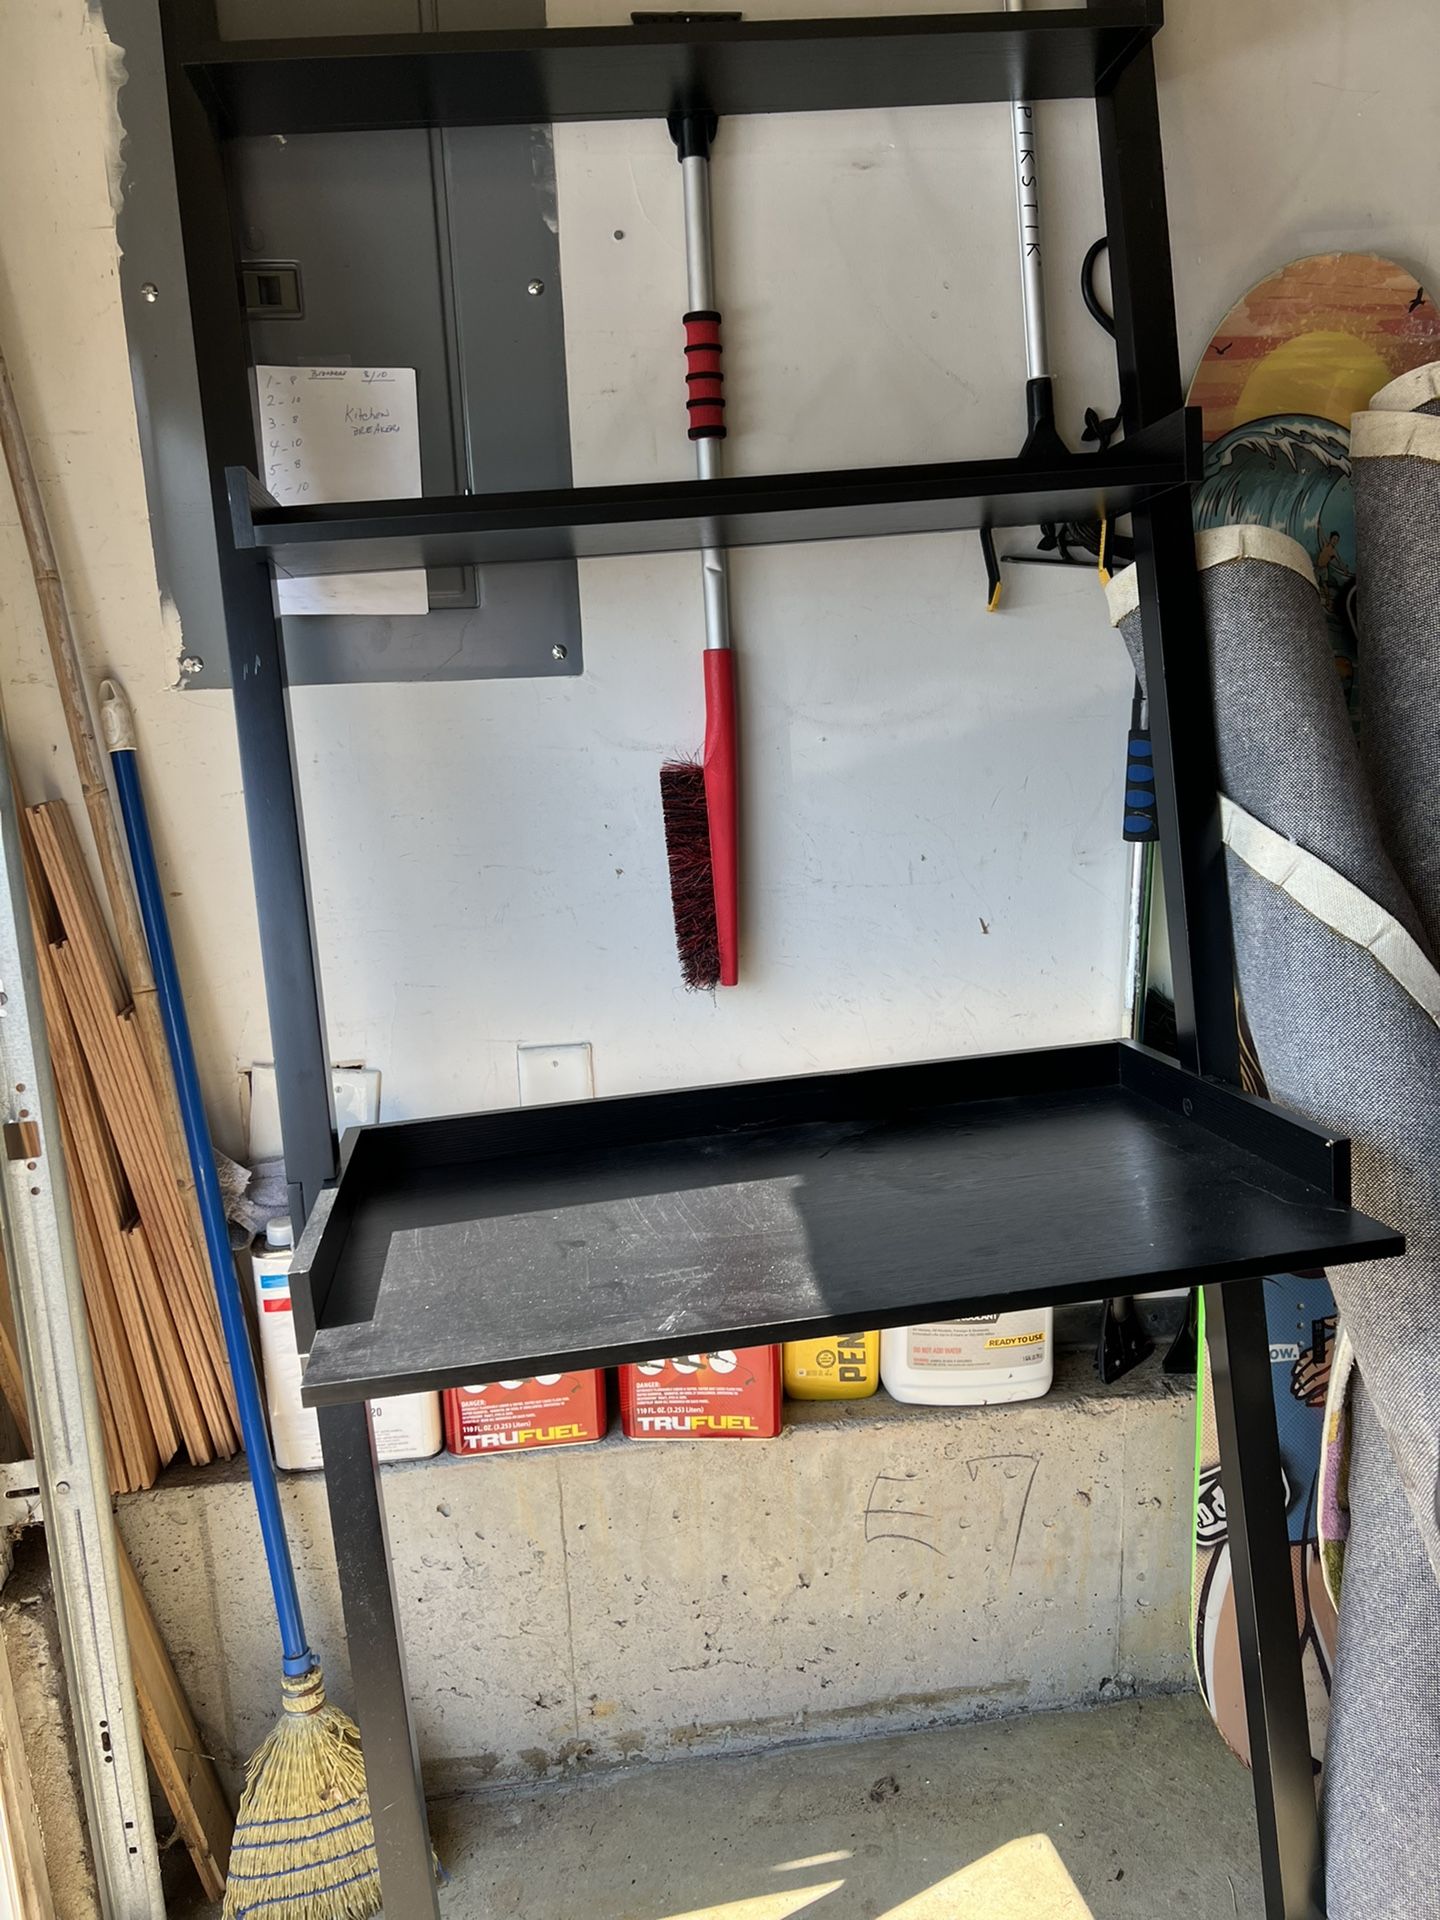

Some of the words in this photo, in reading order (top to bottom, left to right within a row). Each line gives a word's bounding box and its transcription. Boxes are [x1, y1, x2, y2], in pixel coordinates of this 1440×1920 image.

[1017, 105, 1041, 256] PIKSTIK
[988, 1337, 1017, 1347] READY
[1017, 1336, 1028, 1344] TO
[1028, 1332, 1044, 1342] USE
[647, 1406, 656, 1414] FL.
[657, 1406, 667, 1414] OZ.
[685, 1405, 705, 1414] Liters)
[463, 1425, 474, 1433] 110
[474, 1424, 483, 1432] FL.
[483, 1423, 494, 1431] OZ.
[512, 1420, 532, 1430] Liters)
[636, 1415, 759, 1432] TRUFUEL
[463, 1423, 588, 1449] TRUFUEL
